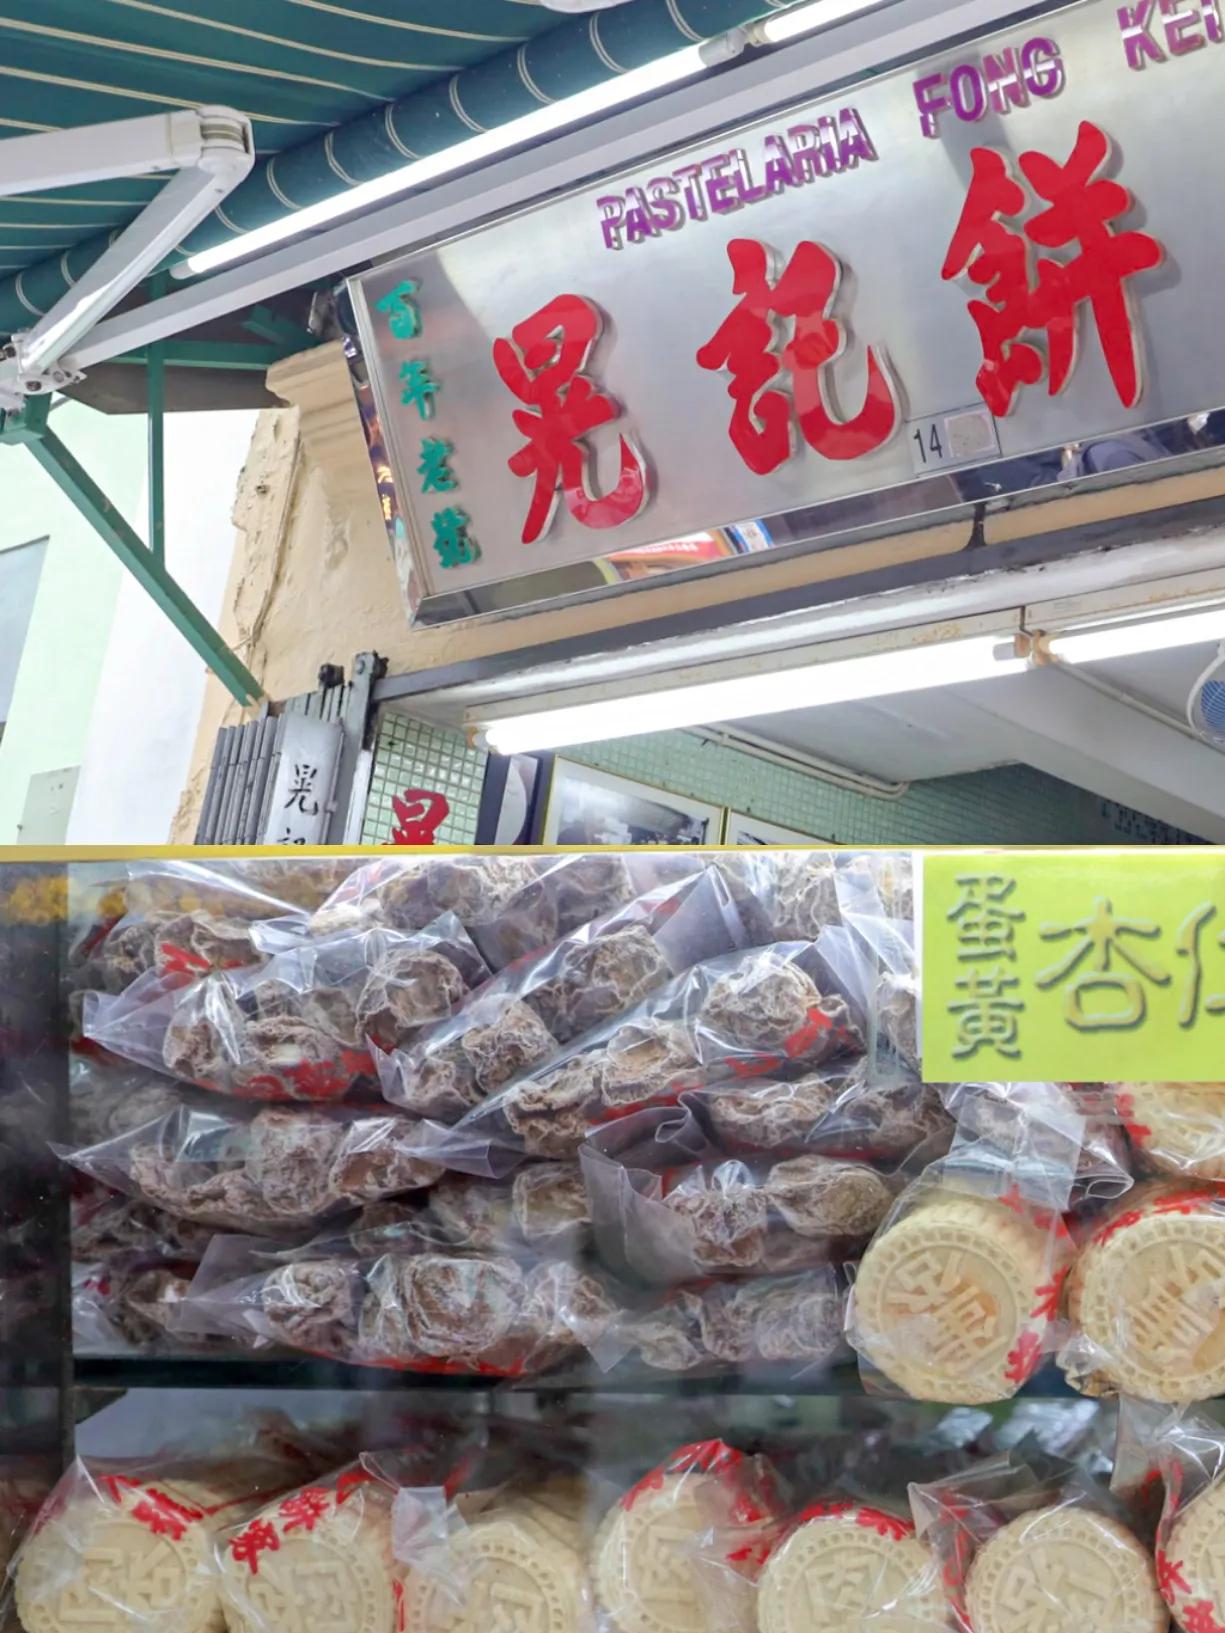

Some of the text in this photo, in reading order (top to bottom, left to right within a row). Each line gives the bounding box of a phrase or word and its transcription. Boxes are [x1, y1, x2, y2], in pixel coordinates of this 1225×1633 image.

[597, 0, 1225, 250] PASTELARIA FONG KEI
[912, 422, 944, 461] 14
[946, 873, 1025, 1061] 蛋黃
